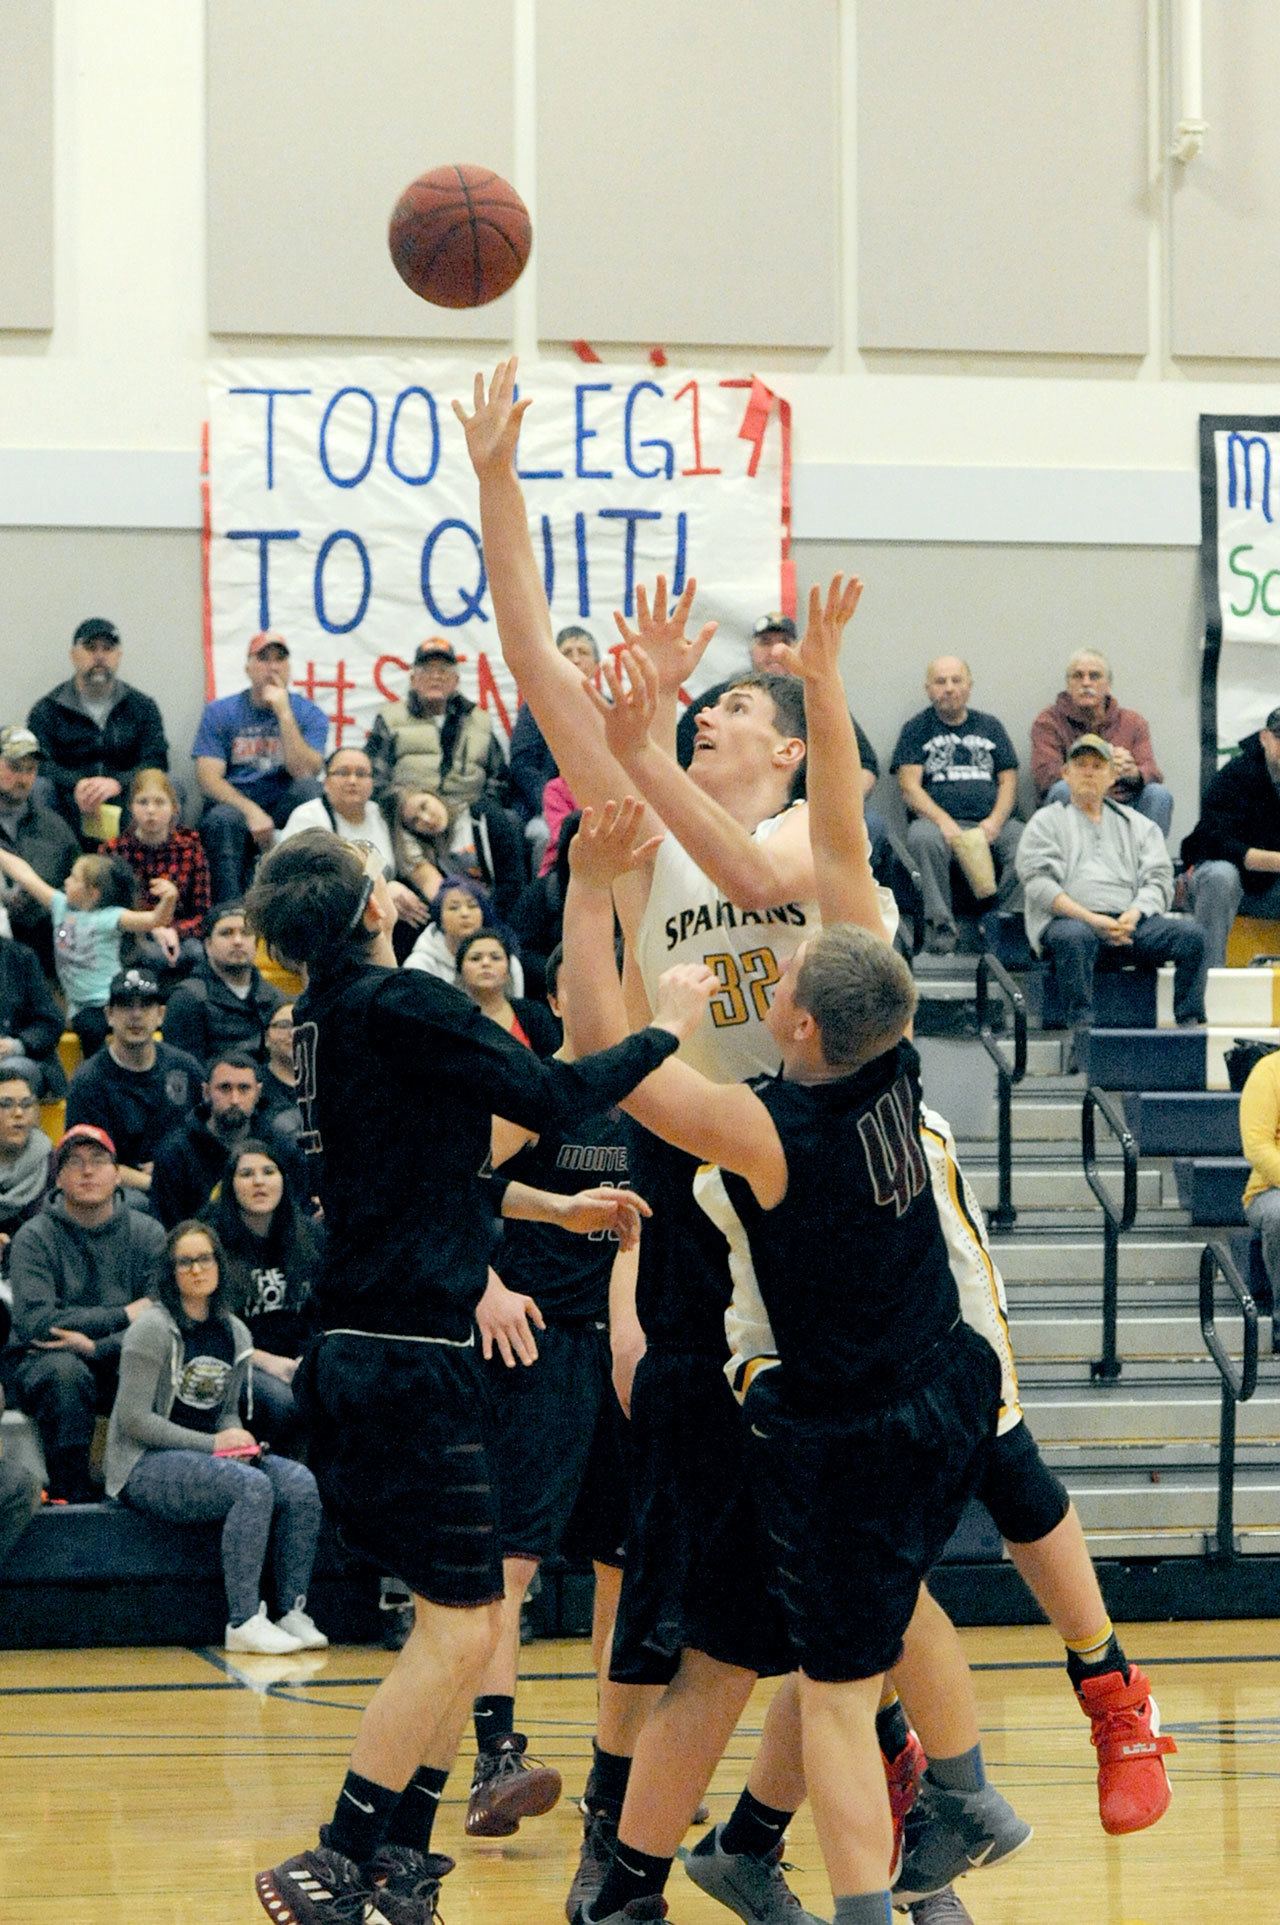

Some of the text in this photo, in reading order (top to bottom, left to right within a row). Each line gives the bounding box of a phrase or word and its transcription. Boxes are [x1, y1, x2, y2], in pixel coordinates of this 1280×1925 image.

[229, 385, 442, 491] TOO
[226, 529, 373, 635] TO
[665, 898, 806, 951] SPAANS
[703, 946, 781, 1028] 32
